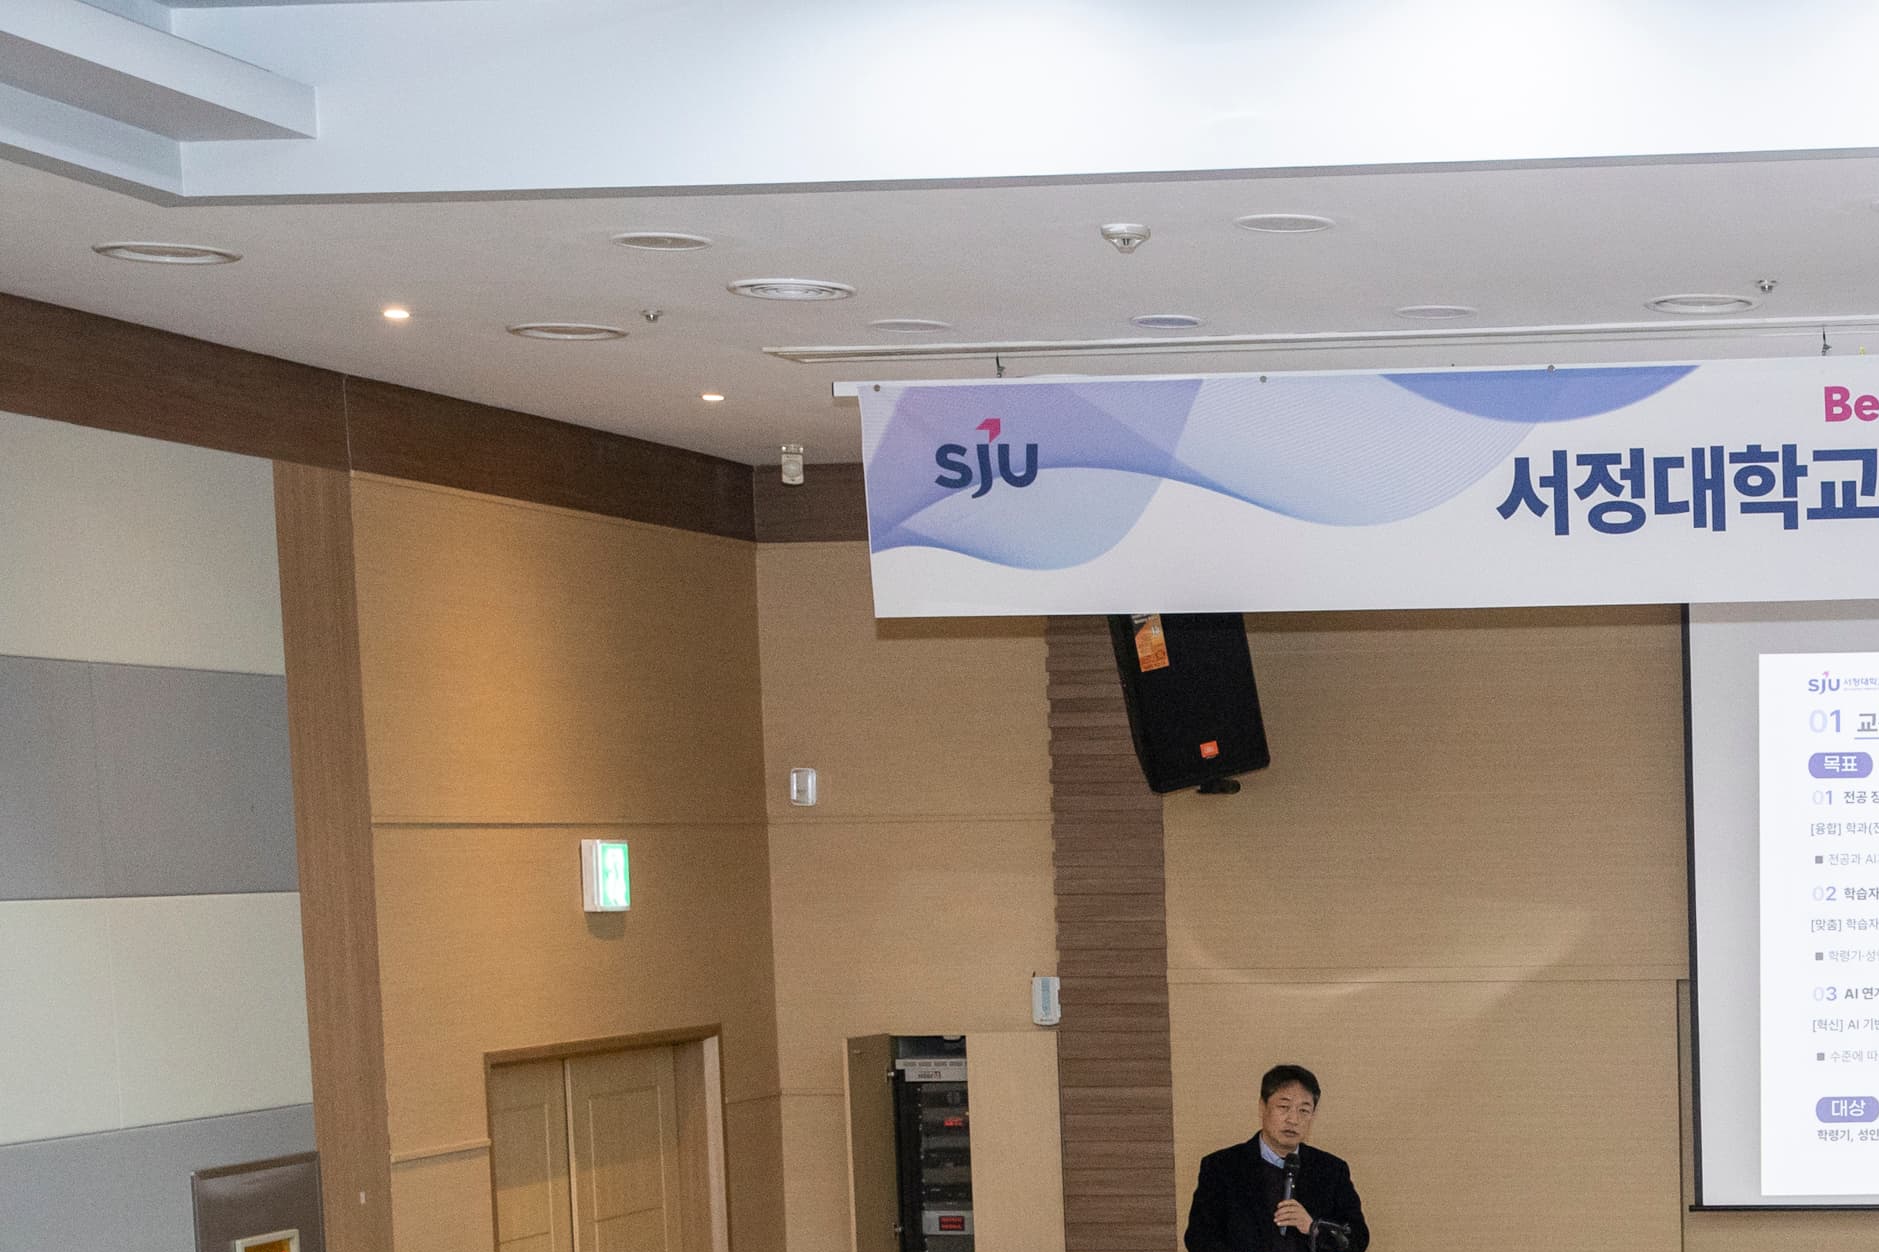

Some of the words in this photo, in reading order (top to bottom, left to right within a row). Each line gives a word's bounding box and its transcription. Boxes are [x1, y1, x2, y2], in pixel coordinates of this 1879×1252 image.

[935, 419, 1038, 498] SJU
[1809, 710, 1842, 735] 01
[1824, 756, 1858, 773] 목표
[1844, 790, 1867, 804] 전공
[1810, 822, 1841, 836] [융합]
[1844, 887, 1879, 900] 학습자
[1810, 918, 1842, 933] [맞춤]
[1846, 917, 1878, 930] 학습자
[1844, 988, 1858, 999] AI
[1812, 1018, 1843, 1032] [혁신]
[1847, 1019, 1859, 1029] AI
[1831, 1099, 1866, 1117] 대상
[1817, 1128, 1853, 1142] 학령기,
